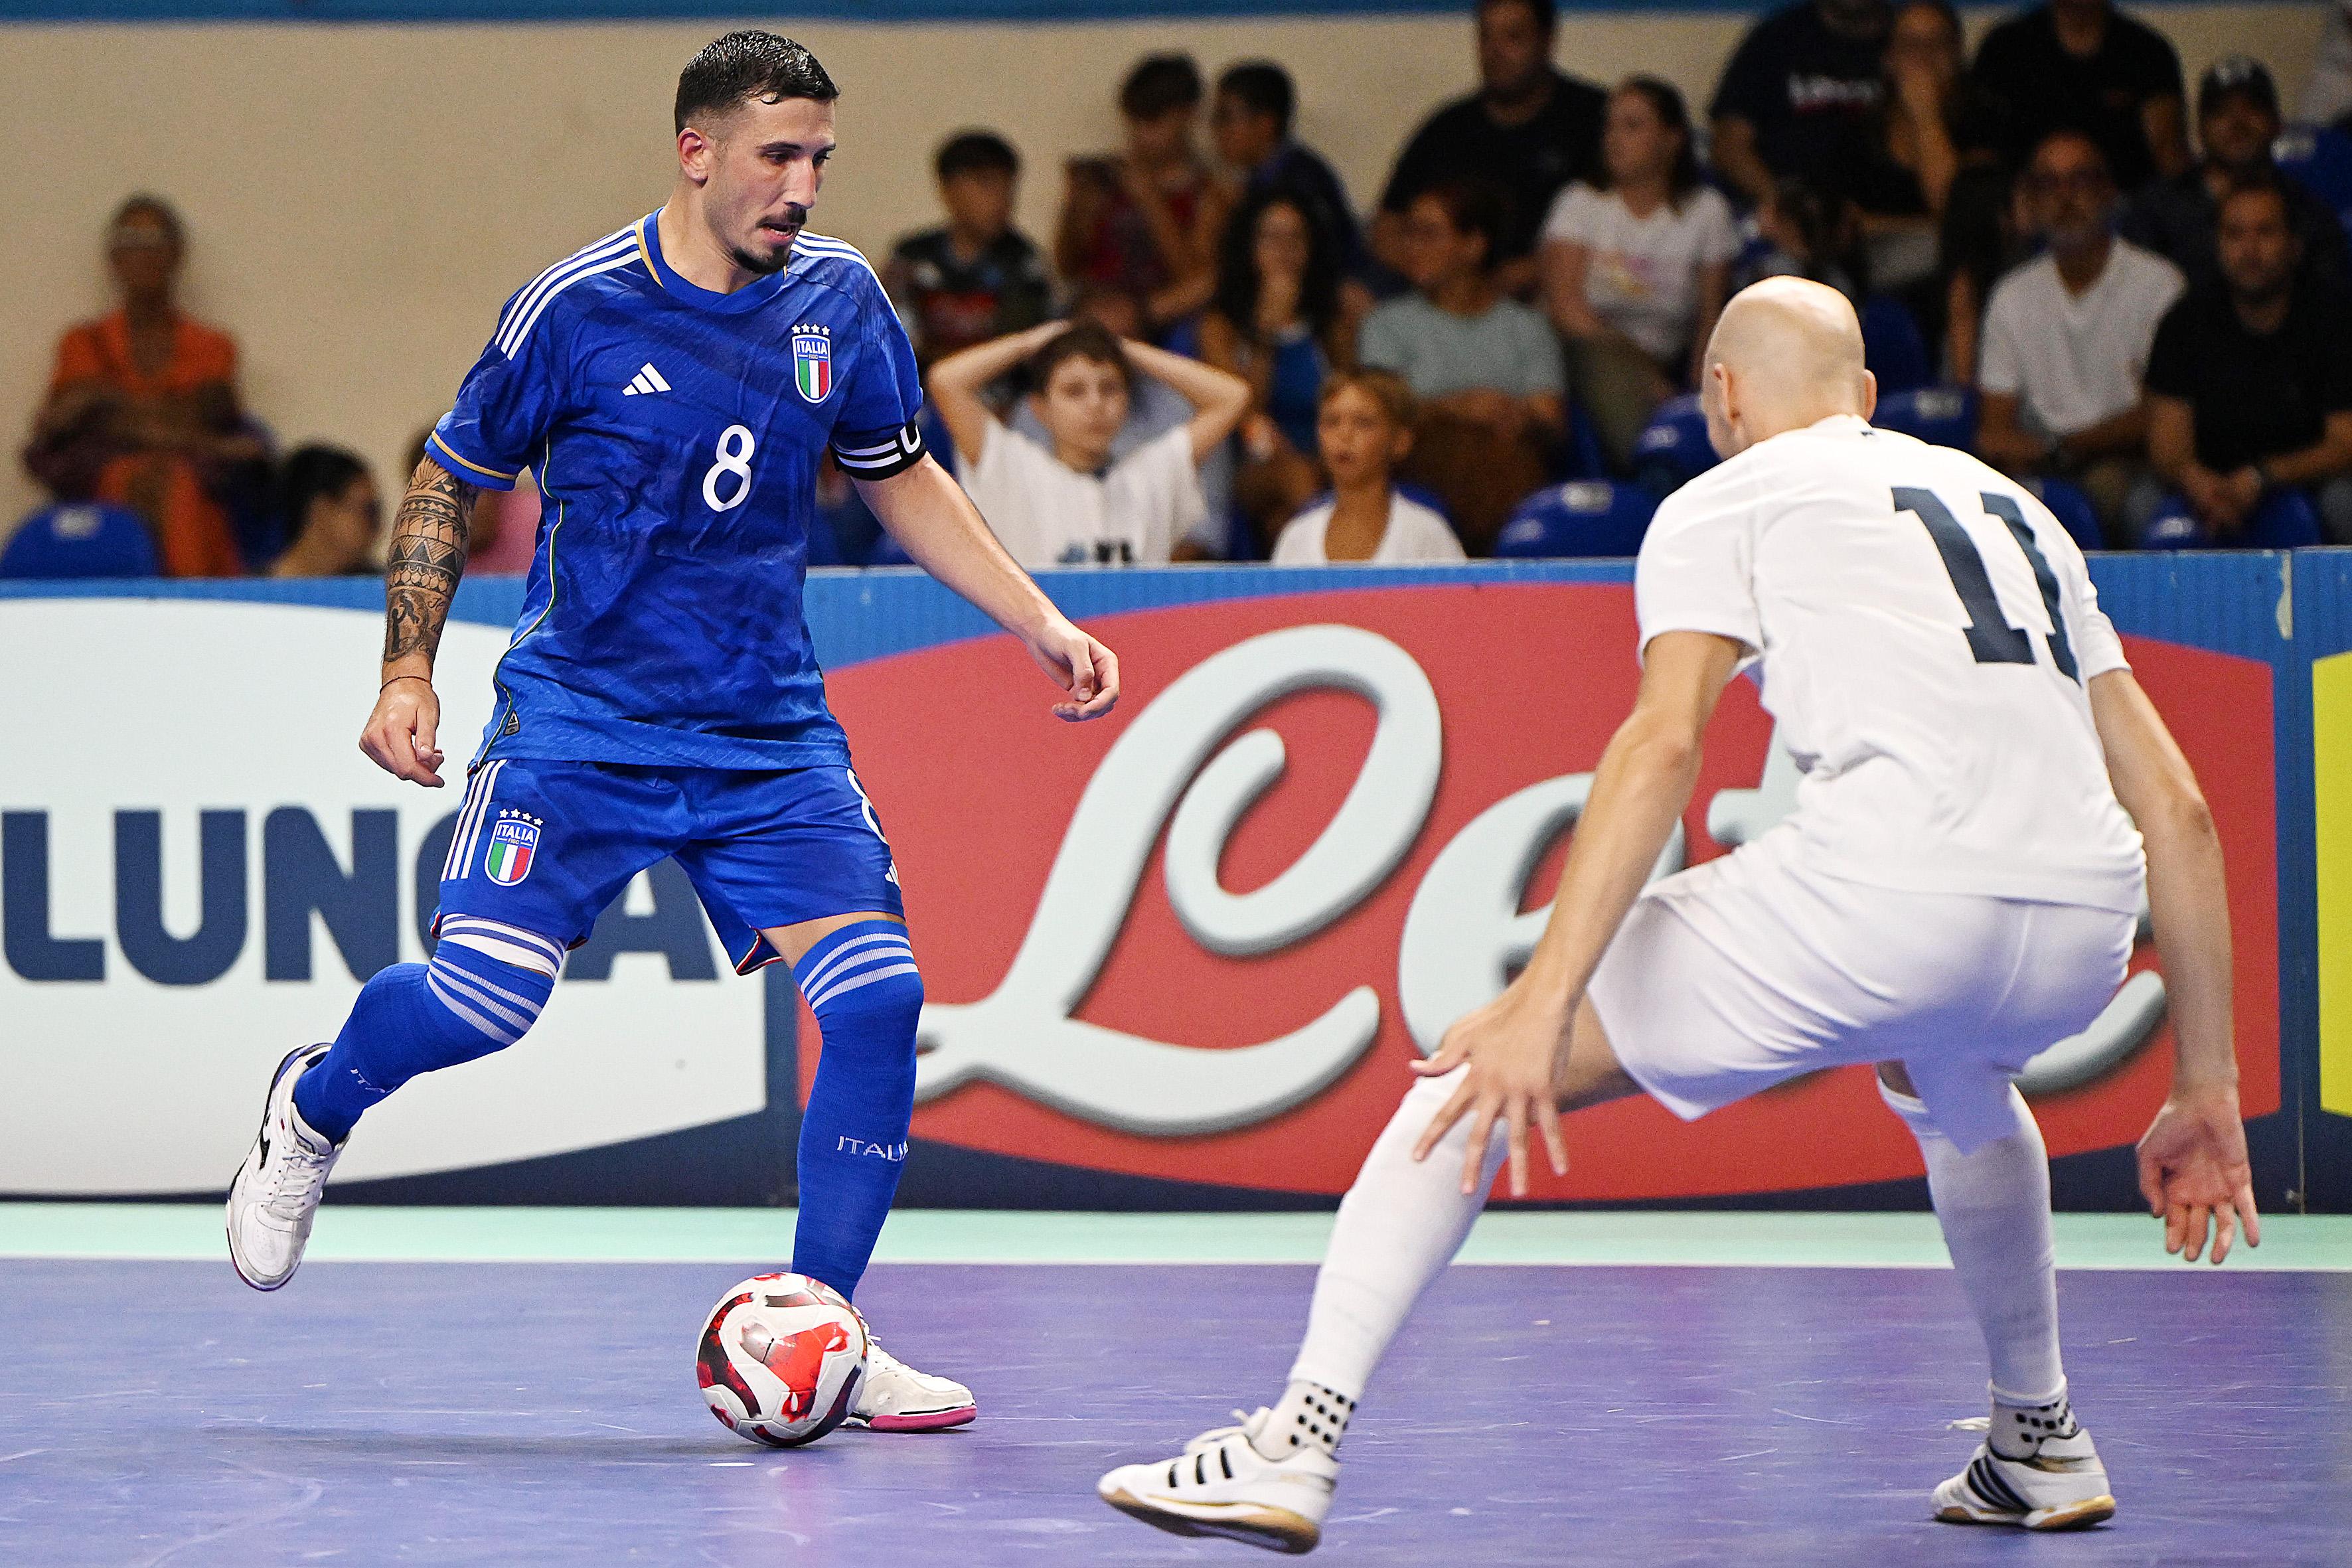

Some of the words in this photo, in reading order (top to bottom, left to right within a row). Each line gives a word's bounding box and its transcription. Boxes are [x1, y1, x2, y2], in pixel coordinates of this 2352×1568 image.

[797, 340, 828, 354] ITALIA
[702, 424, 755, 512] 8
[1891, 486, 2082, 674] 11
[497, 824, 534, 843] ITALIA
